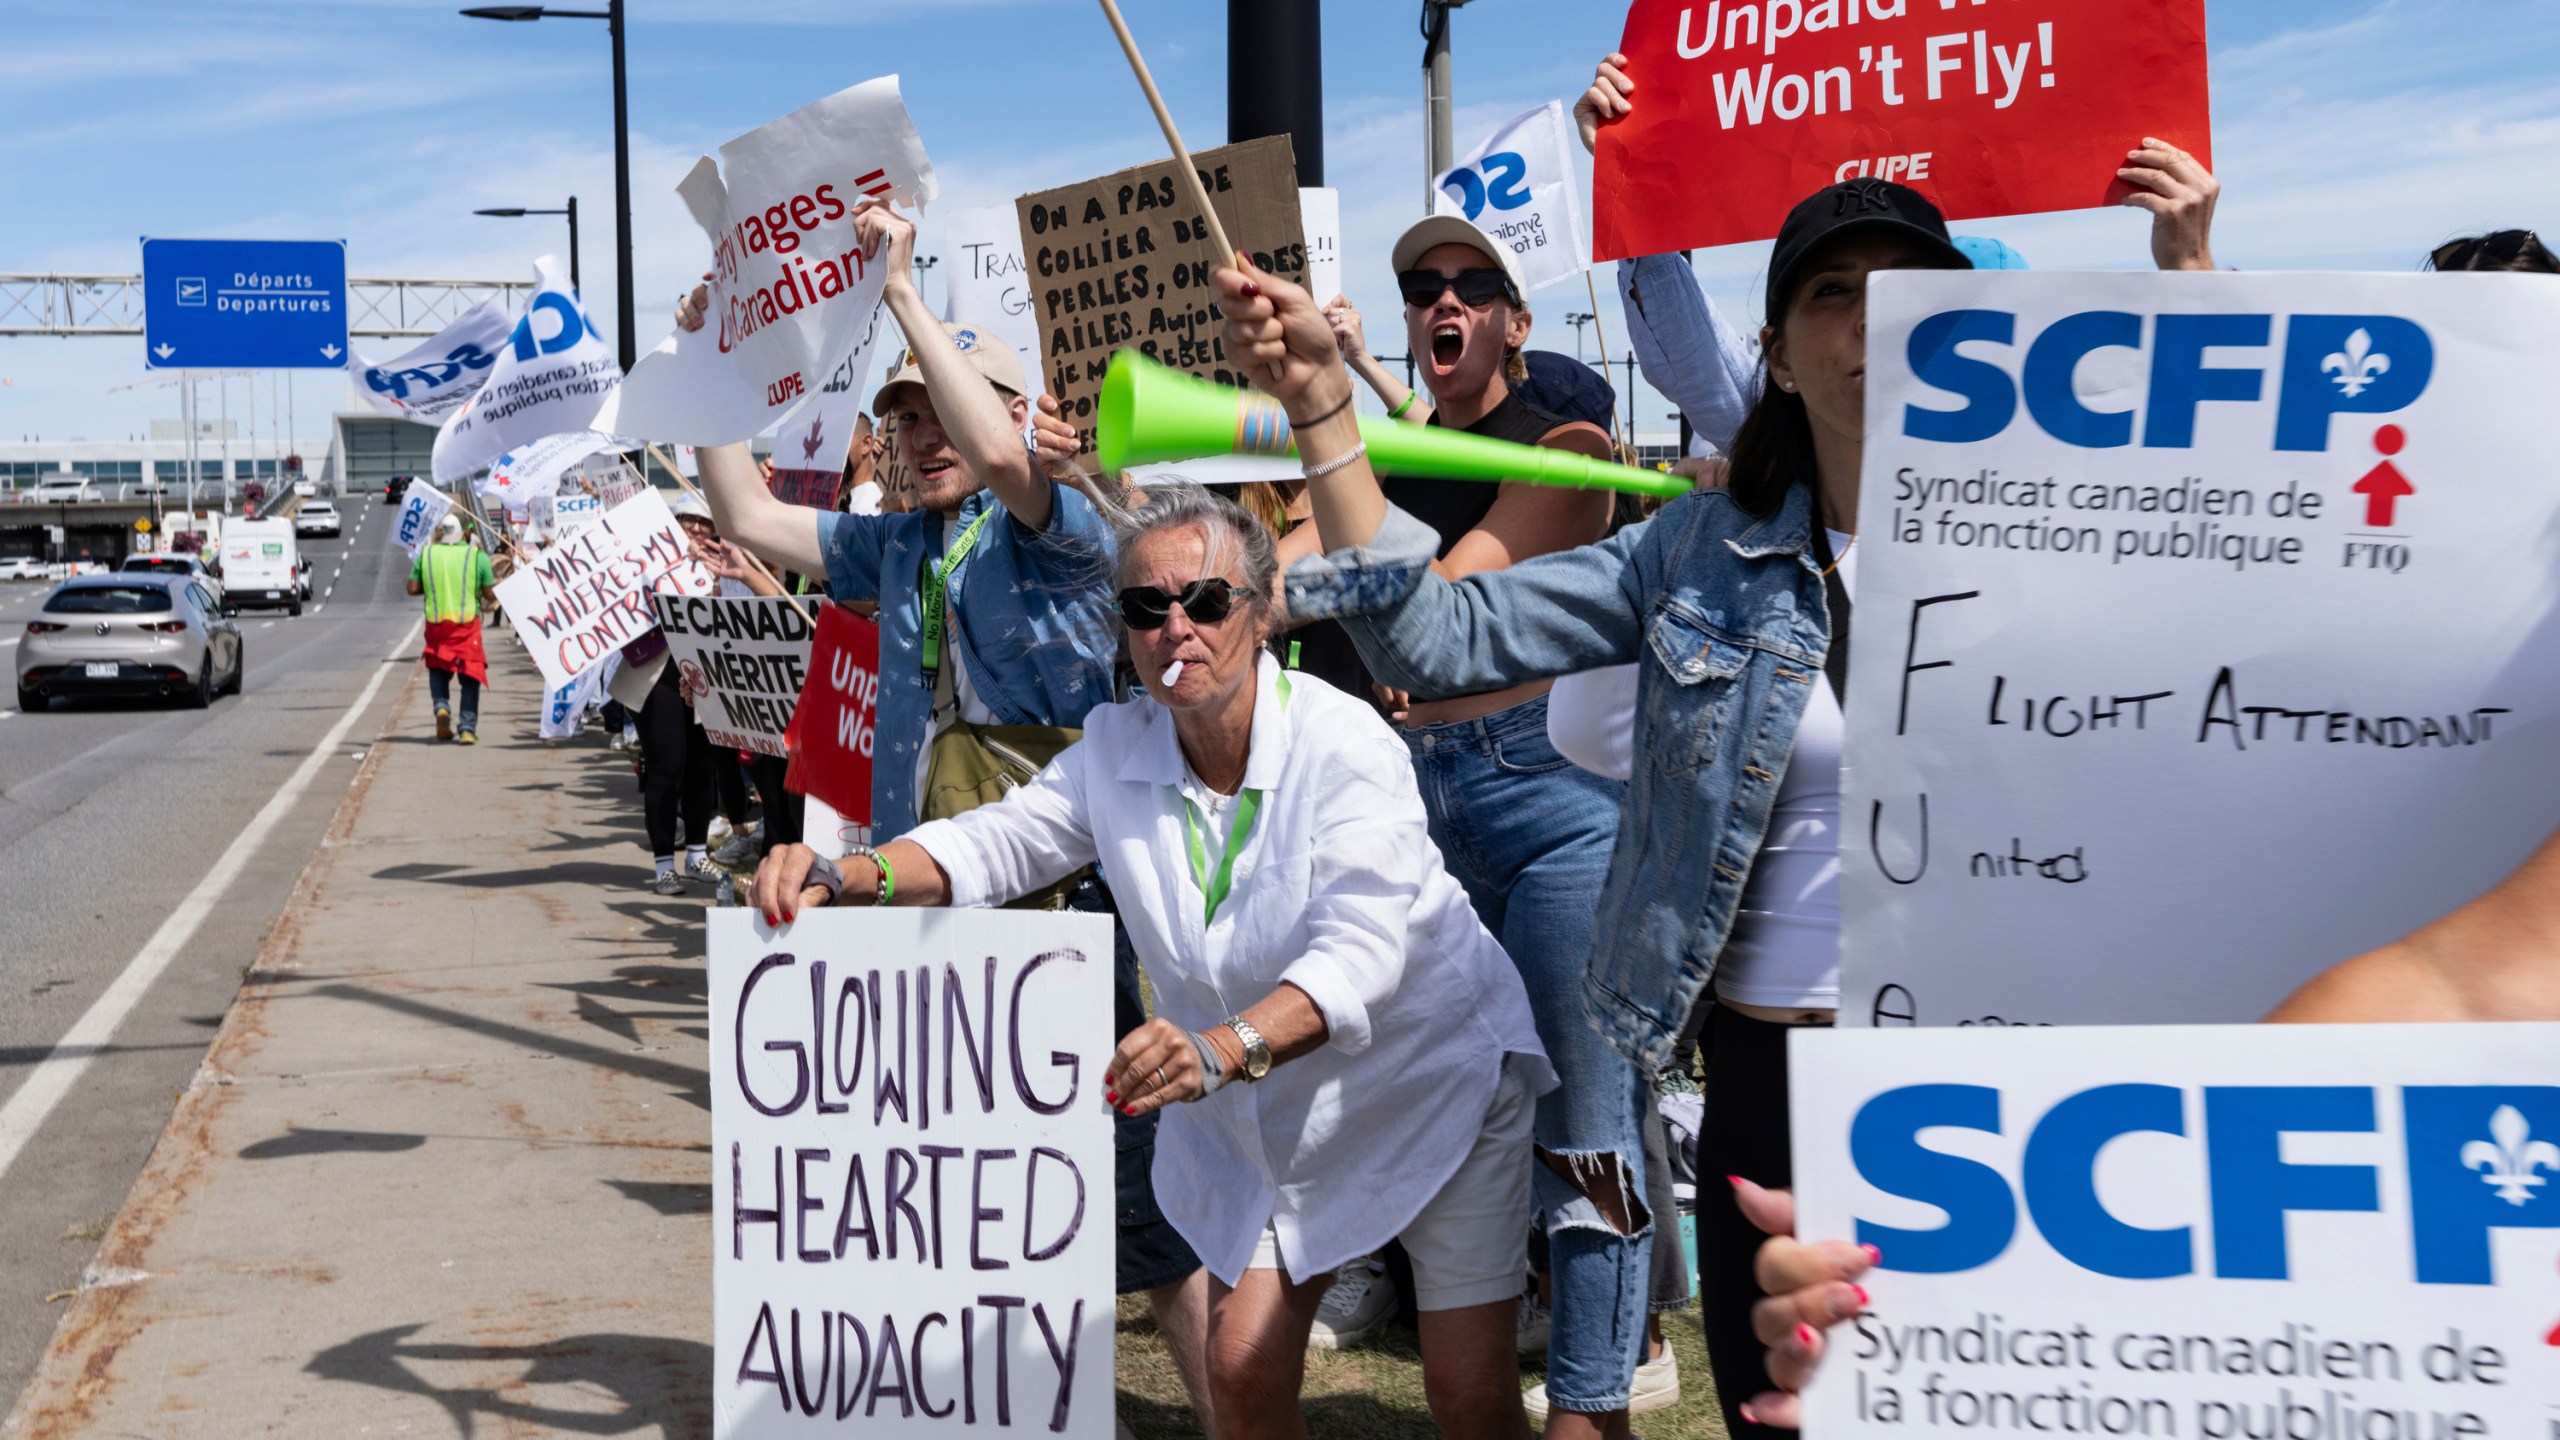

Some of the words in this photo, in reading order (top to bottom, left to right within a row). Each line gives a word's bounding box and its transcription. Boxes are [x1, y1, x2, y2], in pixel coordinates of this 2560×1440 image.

[1712, 45, 1904, 130] Won't
[1925, 22, 2055, 109] Fly!
[1030, 203, 1068, 235] ON
[1083, 197, 1106, 224] A
[1117, 176, 1176, 216] PAS
[1197, 165, 1232, 197] DE
[1173, 214, 1209, 245] DE
[217, 297, 331, 314] Departures
[234, 272, 313, 290] Départs
[1172, 259, 1210, 291] ON
[1903, 309, 2435, 452] SCFP
[557, 498, 601, 513] SCFP
[603, 481, 640, 505] RIGHT
[1894, 466, 2058, 512] Syndicat
[2068, 476, 2255, 517] canadien
[2267, 480, 2324, 520] de
[1891, 506, 1924, 545] la
[1937, 509, 2101, 555] fonction
[2112, 520, 2304, 572] publique
[2341, 541, 2412, 576] FTQ
[528, 549, 649, 640] WHERE'S
[642, 525, 688, 569] MY
[654, 596, 689, 634] LE
[930, 589, 943, 620] More
[927, 622, 940, 641] No
[696, 640, 806, 694] MÉRITE
[831, 645, 879, 714] Unp
[2197, 666, 2513, 751] ATTENDANT
[735, 949, 1087, 1130] GLOWING
[732, 1141, 1086, 1270] HEARTED
[1848, 1082, 2560, 1287] SCFP
[735, 1295, 1085, 1433] AUDACITY
[1852, 1310, 2098, 1376] Syndicat
[2111, 1322, 2403, 1384] canadien
[2421, 1326, 2508, 1387] de
[1854, 1368, 1903, 1426] la
[1920, 1371, 2179, 1438] fonction
[2200, 1388, 2491, 1440] publique
